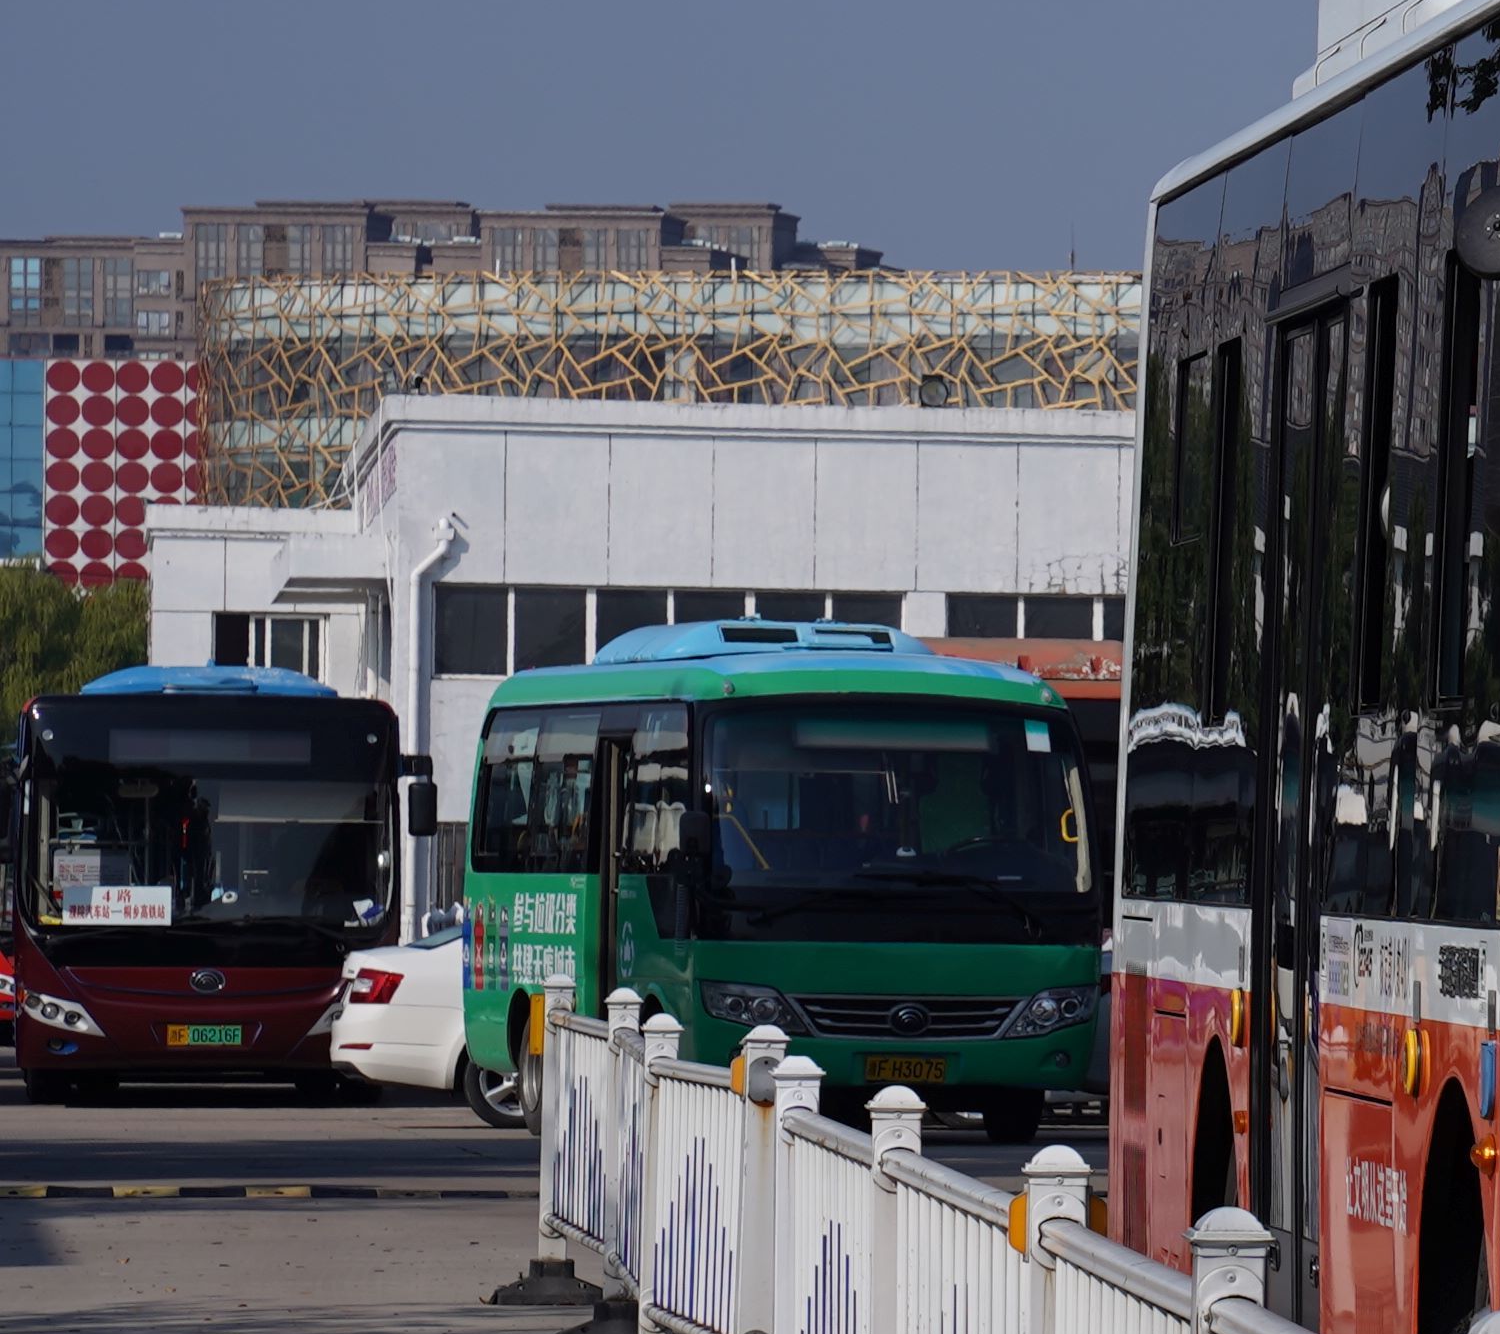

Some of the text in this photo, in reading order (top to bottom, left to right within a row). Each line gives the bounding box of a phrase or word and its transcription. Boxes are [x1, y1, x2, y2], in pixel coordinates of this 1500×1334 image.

[513, 892, 577, 935] 参与垃圾分类
